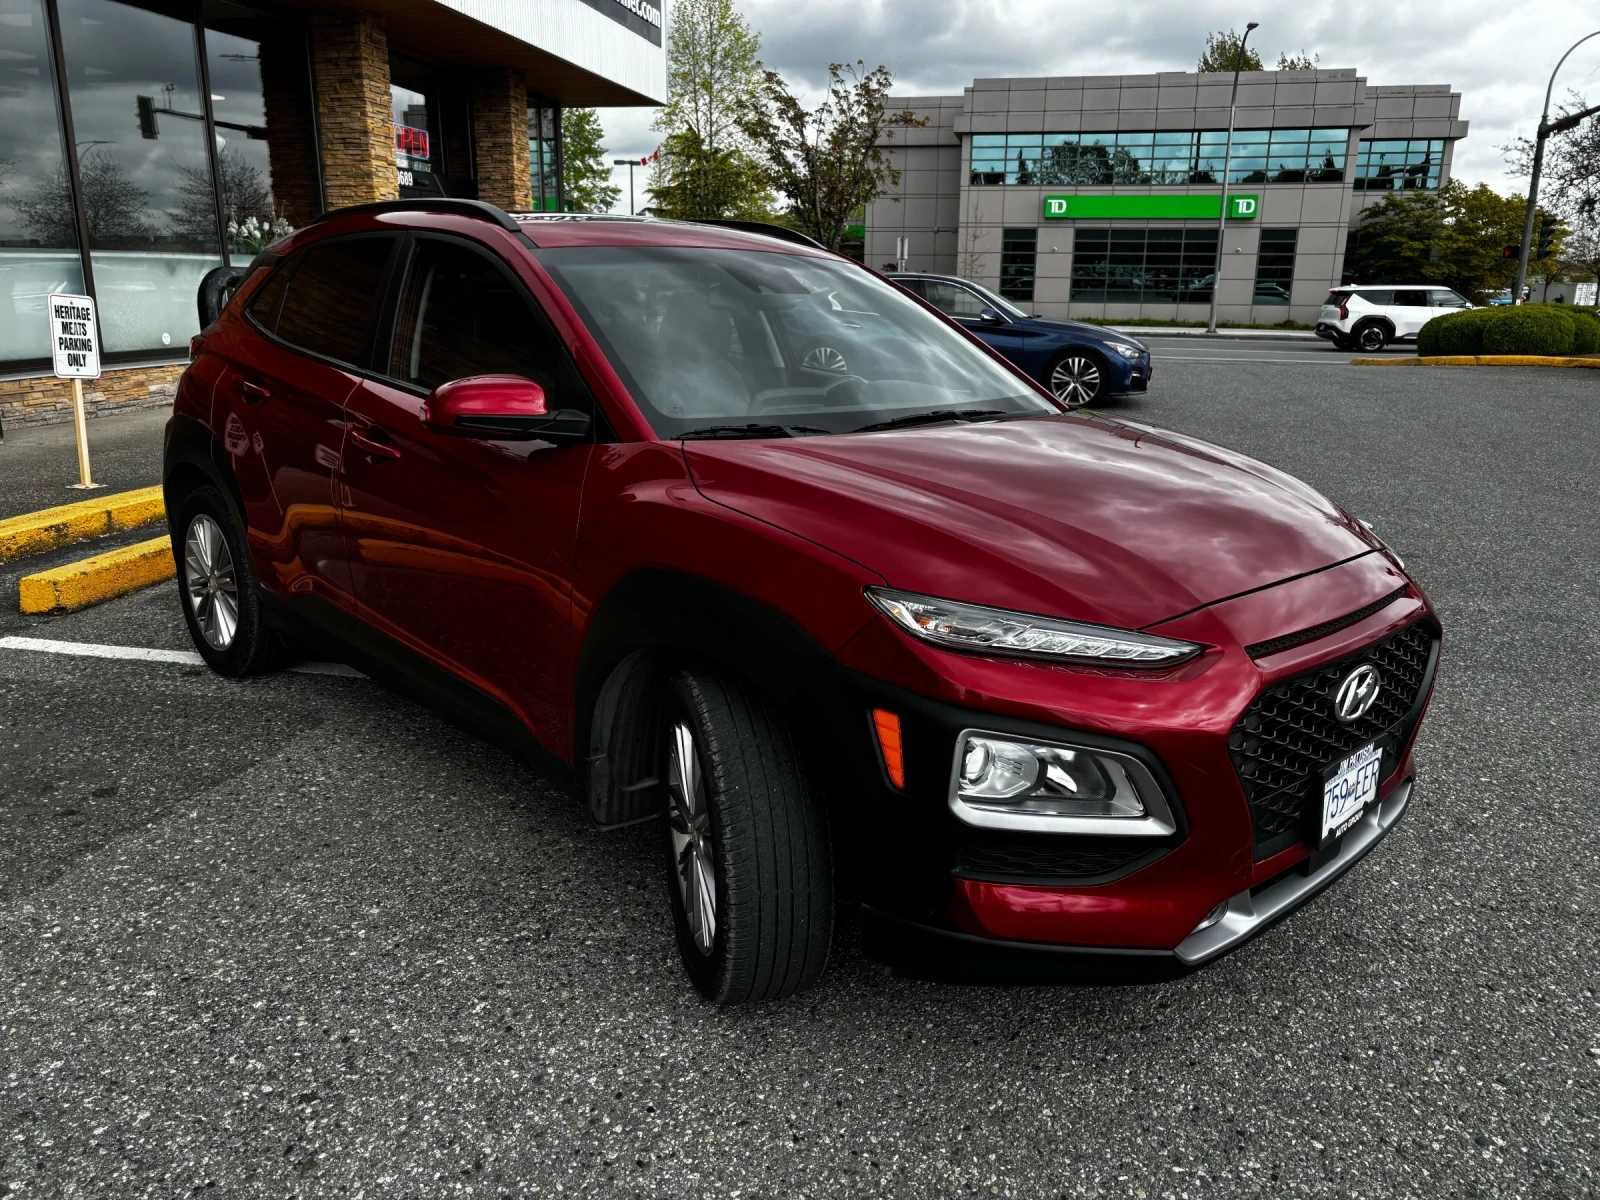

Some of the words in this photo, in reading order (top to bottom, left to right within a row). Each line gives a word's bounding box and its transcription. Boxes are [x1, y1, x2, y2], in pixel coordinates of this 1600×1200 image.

[394, 126, 429, 158] OPEN
[1047, 199, 1067, 214] TD
[1235, 198, 1255, 214] TD
[54, 304, 91, 321] HERITAGE
[61, 321, 87, 336] MEATS
[58, 336, 92, 352] PARKING
[67, 352, 86, 367] ONLY
[1324, 778, 1348, 825] 759
[1335, 822, 1348, 838] AUTO
